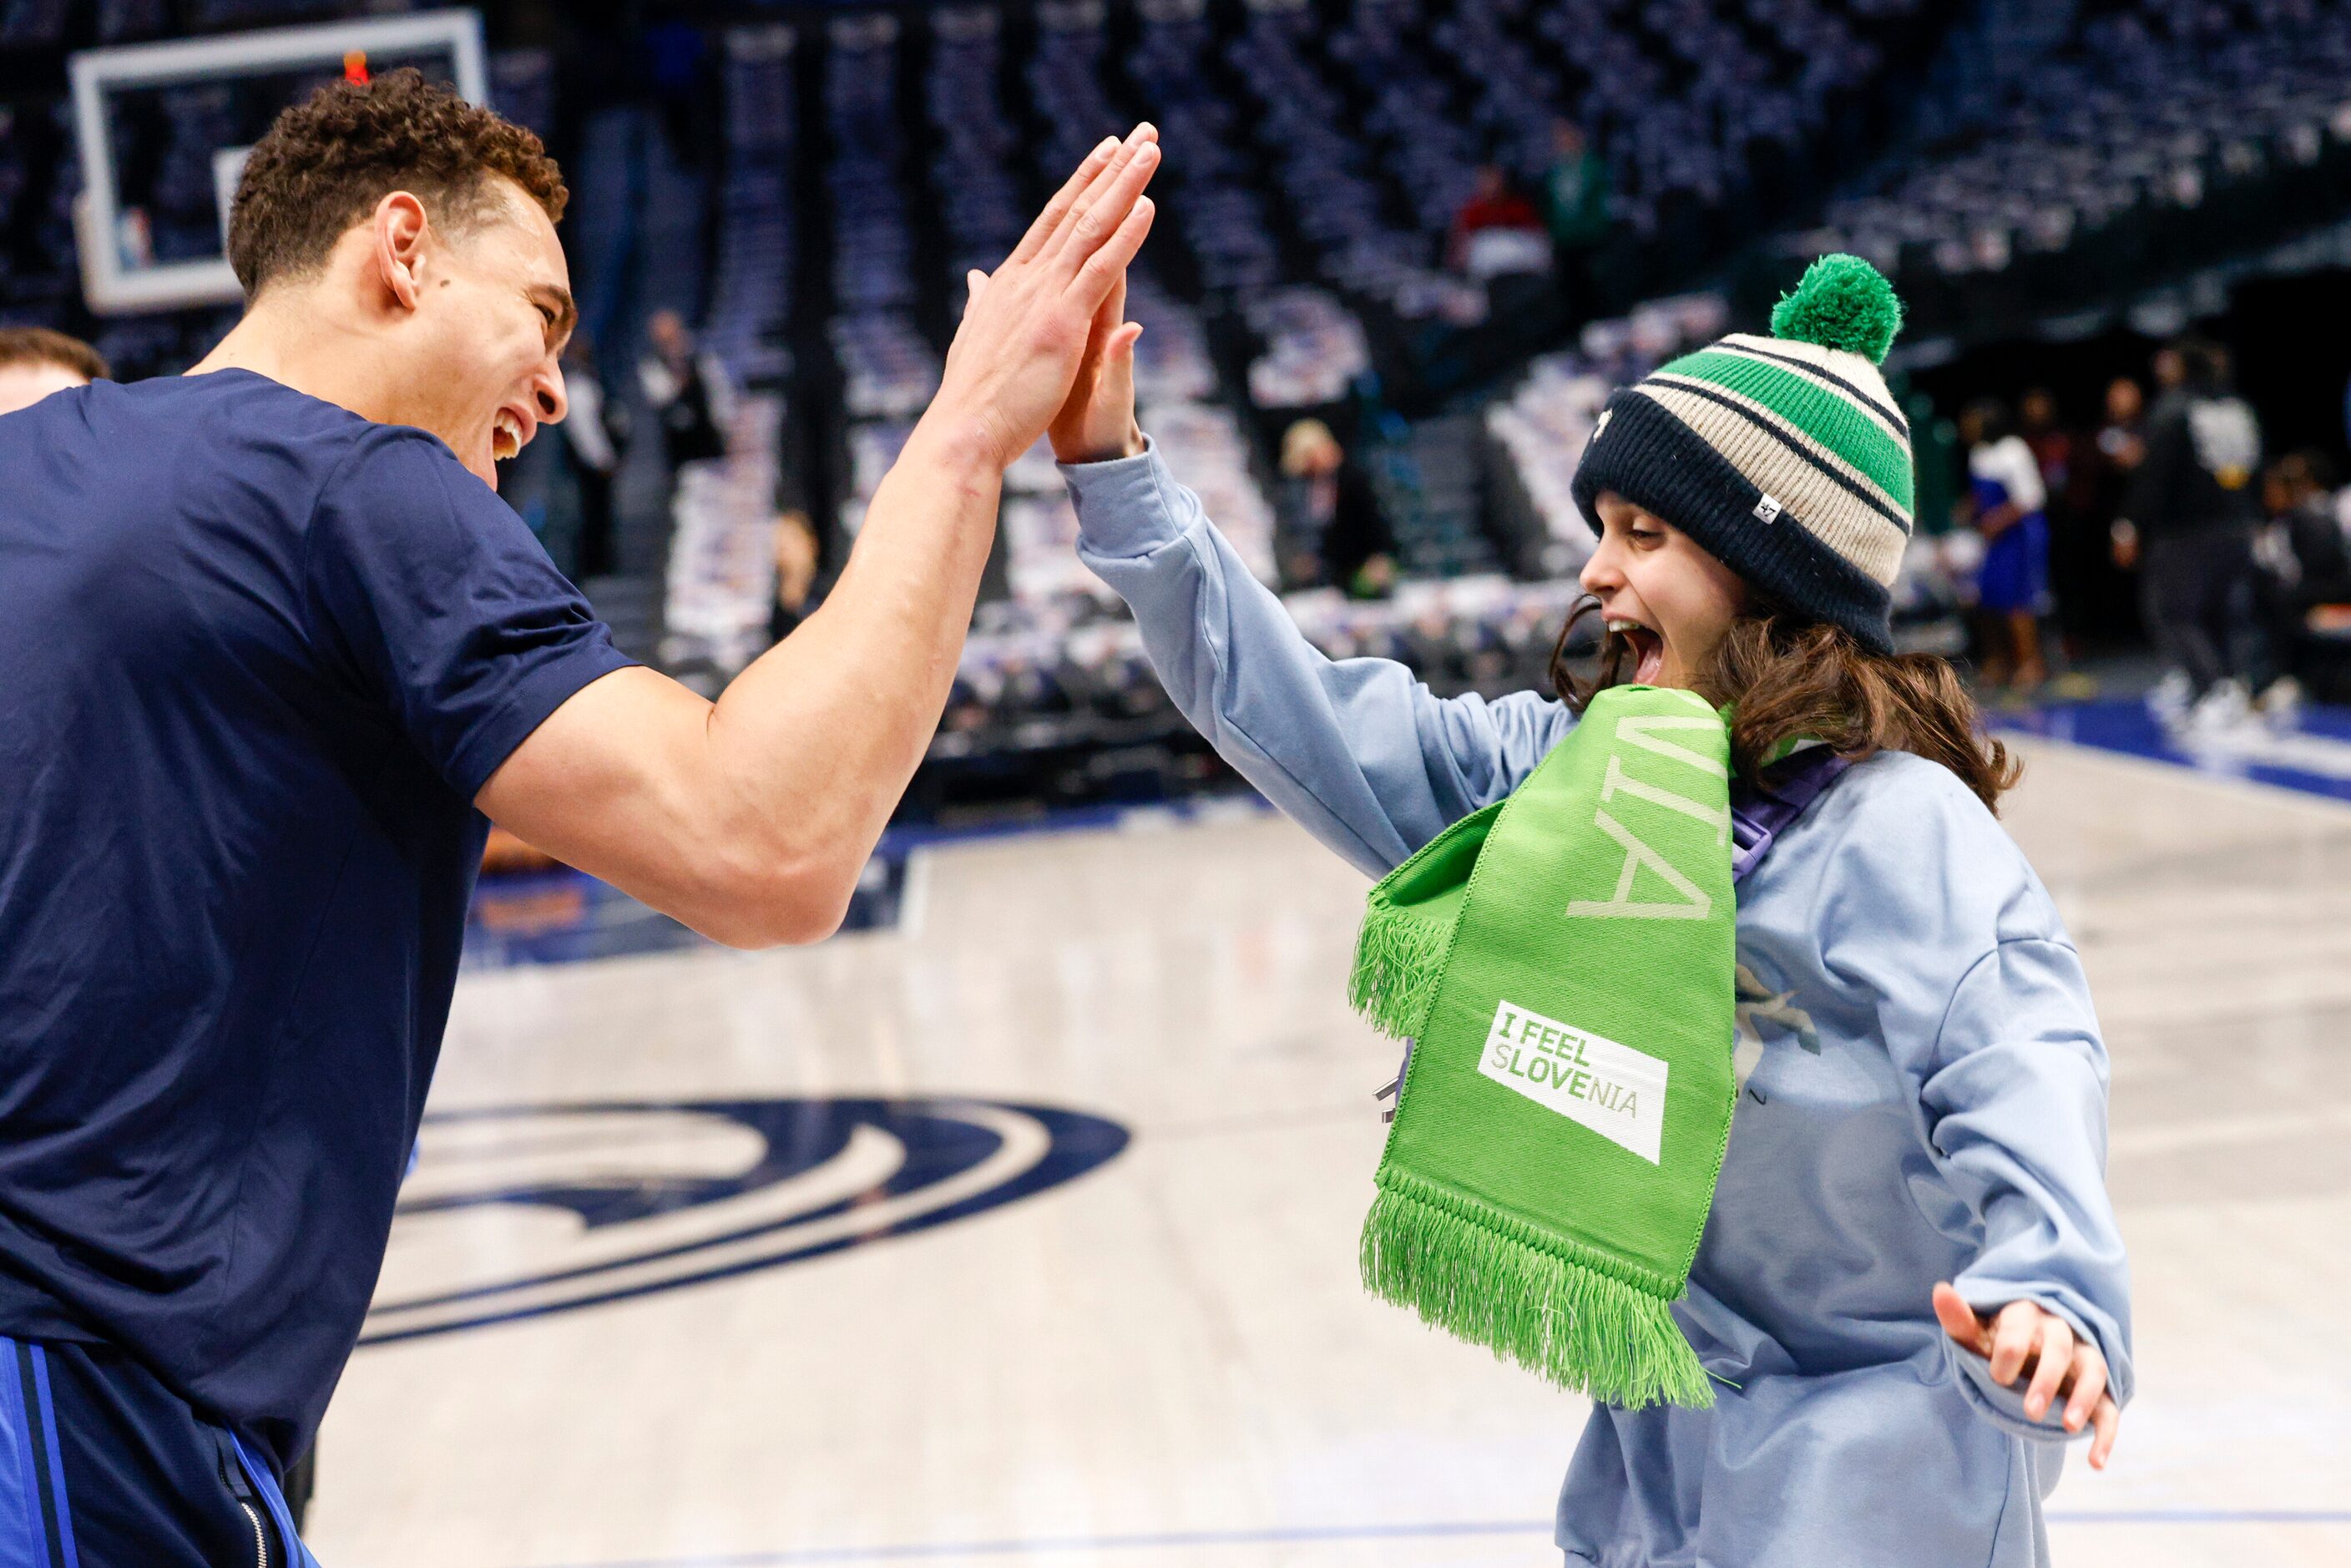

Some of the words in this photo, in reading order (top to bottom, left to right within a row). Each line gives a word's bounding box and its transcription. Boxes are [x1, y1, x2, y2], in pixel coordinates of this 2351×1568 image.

[1499, 1012, 1517, 1039] I
[1519, 1019, 1590, 1067] FEEL
[1491, 1044, 1637, 1119] SLOVENIA
